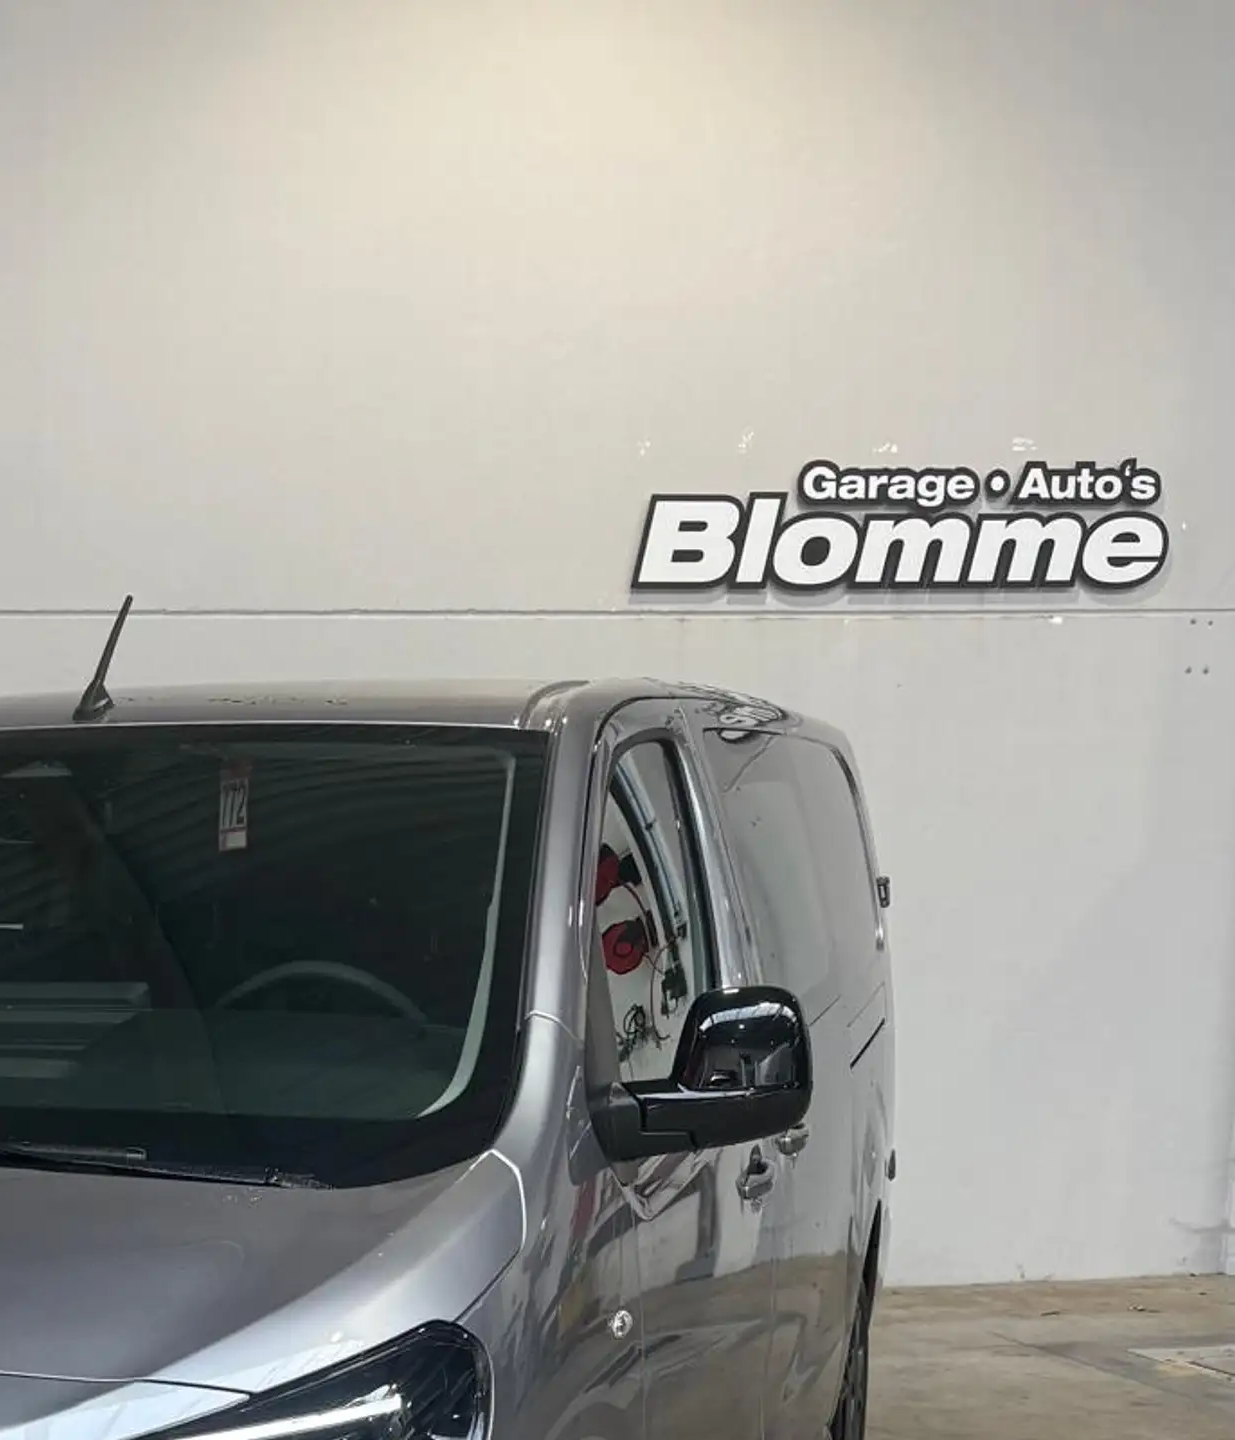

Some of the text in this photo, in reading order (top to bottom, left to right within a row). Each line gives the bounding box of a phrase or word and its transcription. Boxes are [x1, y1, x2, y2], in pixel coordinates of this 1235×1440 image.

[803, 463, 1156, 507] Garage Auto's
[638, 498, 1164, 584] Blomme
